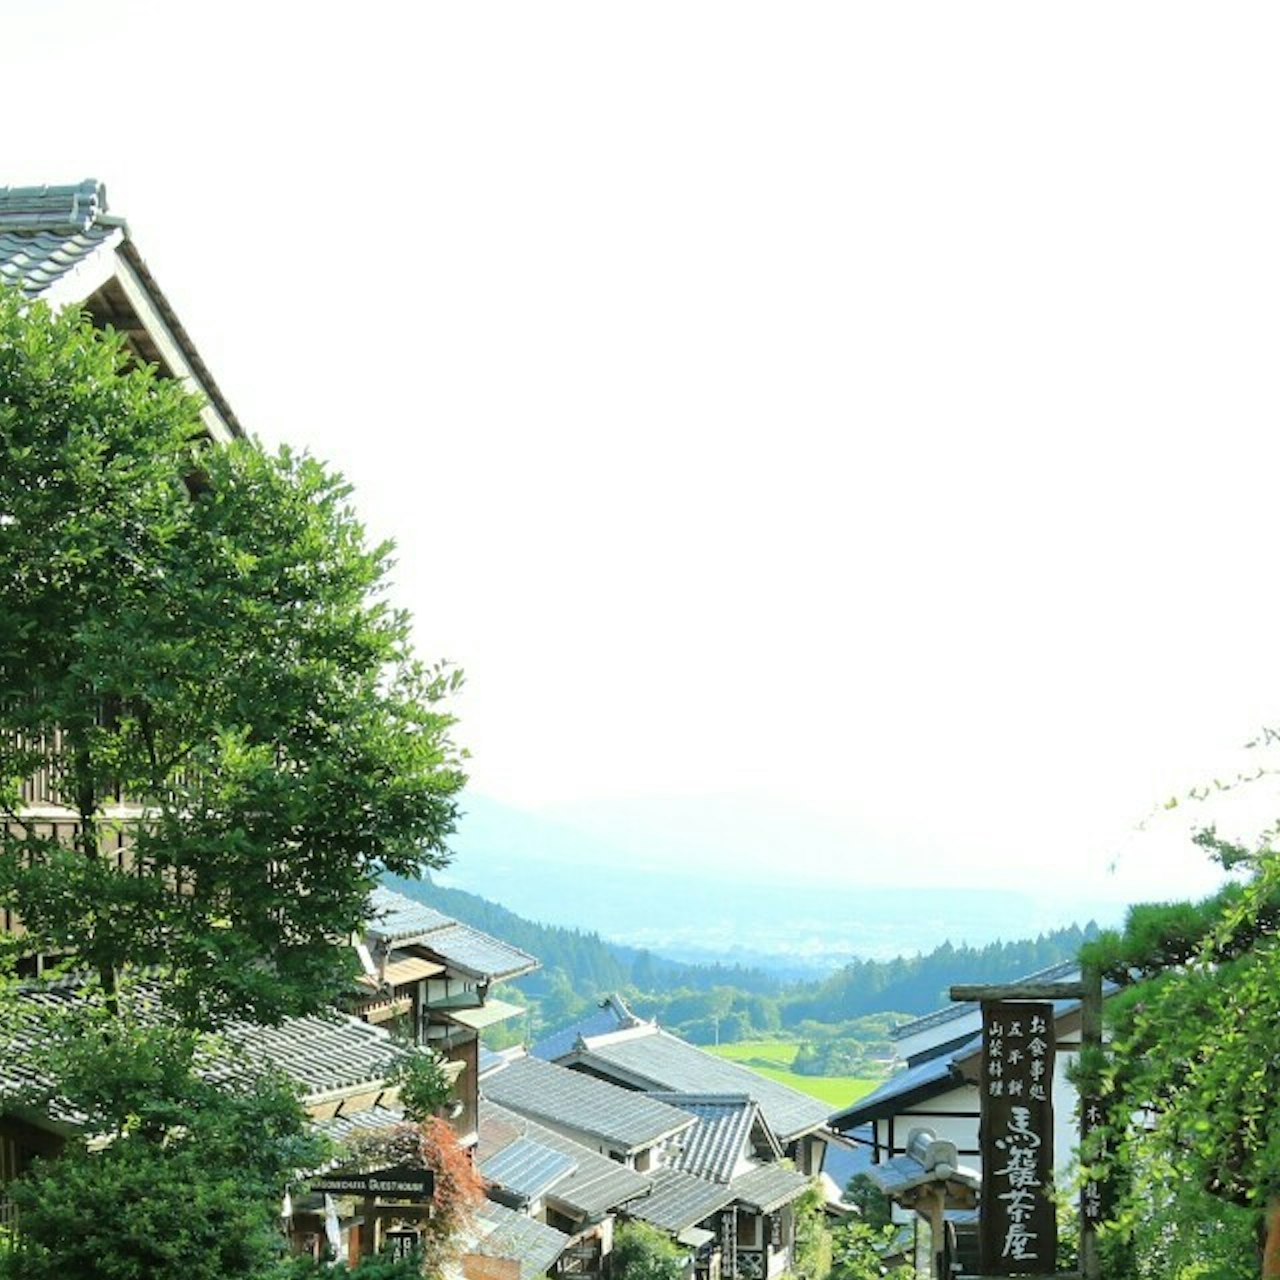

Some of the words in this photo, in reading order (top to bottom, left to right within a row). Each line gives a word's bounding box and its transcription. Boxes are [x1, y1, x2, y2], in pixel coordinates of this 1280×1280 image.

[1027, 1015, 1047, 1101] お食事処
[994, 1106, 1041, 1260] 馬籠茶屋
